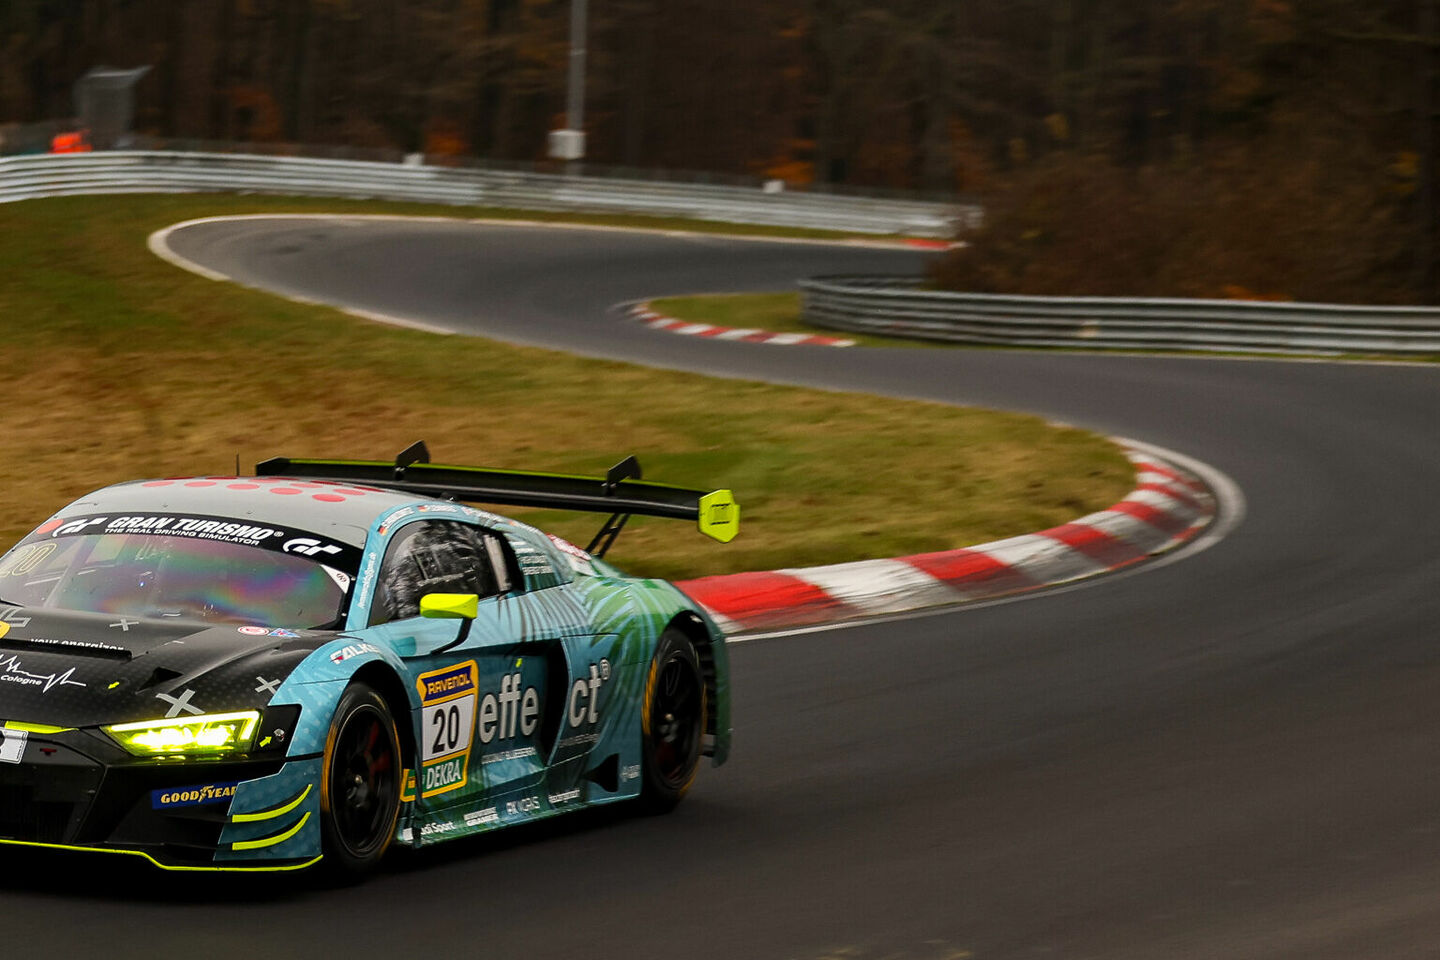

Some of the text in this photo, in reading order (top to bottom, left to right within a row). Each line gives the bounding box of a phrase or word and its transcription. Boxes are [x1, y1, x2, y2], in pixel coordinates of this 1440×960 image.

[107, 515, 172, 534] GRAN
[104, 527, 261, 547] THE REAL DRIVING SIMULATOR
[0, 674, 43, 687] Cologne
[427, 672, 471, 696] RAVENOL
[431, 704, 460, 754] 20
[425, 759, 462, 790] DEKRA
